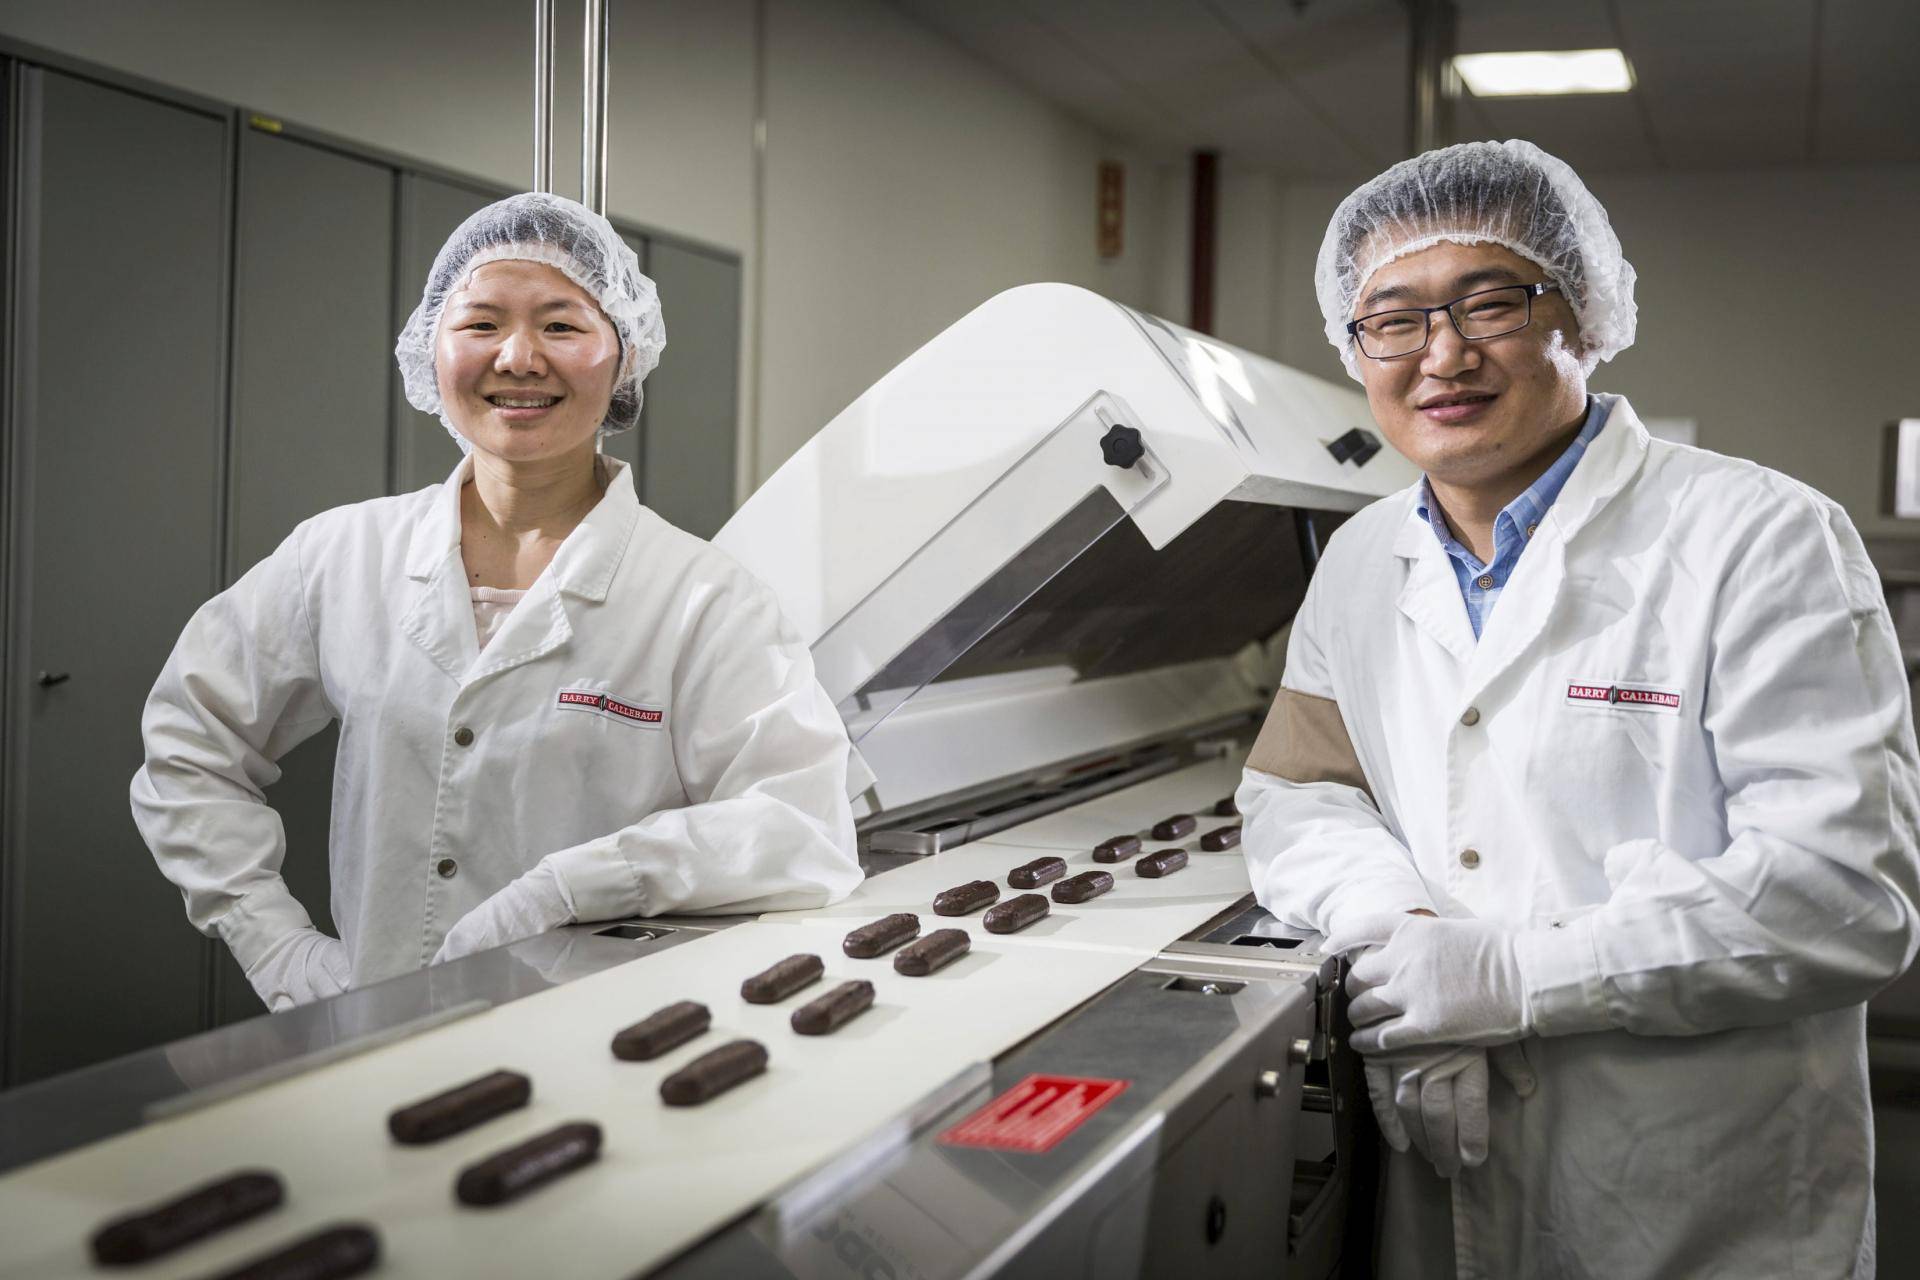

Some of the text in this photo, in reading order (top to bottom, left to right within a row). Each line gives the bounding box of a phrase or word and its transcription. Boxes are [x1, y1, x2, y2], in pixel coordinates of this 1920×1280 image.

[561, 693, 660, 721] BARRY CALLEBAUT
[1569, 686, 1679, 706] BARRY CALLEBAUT
